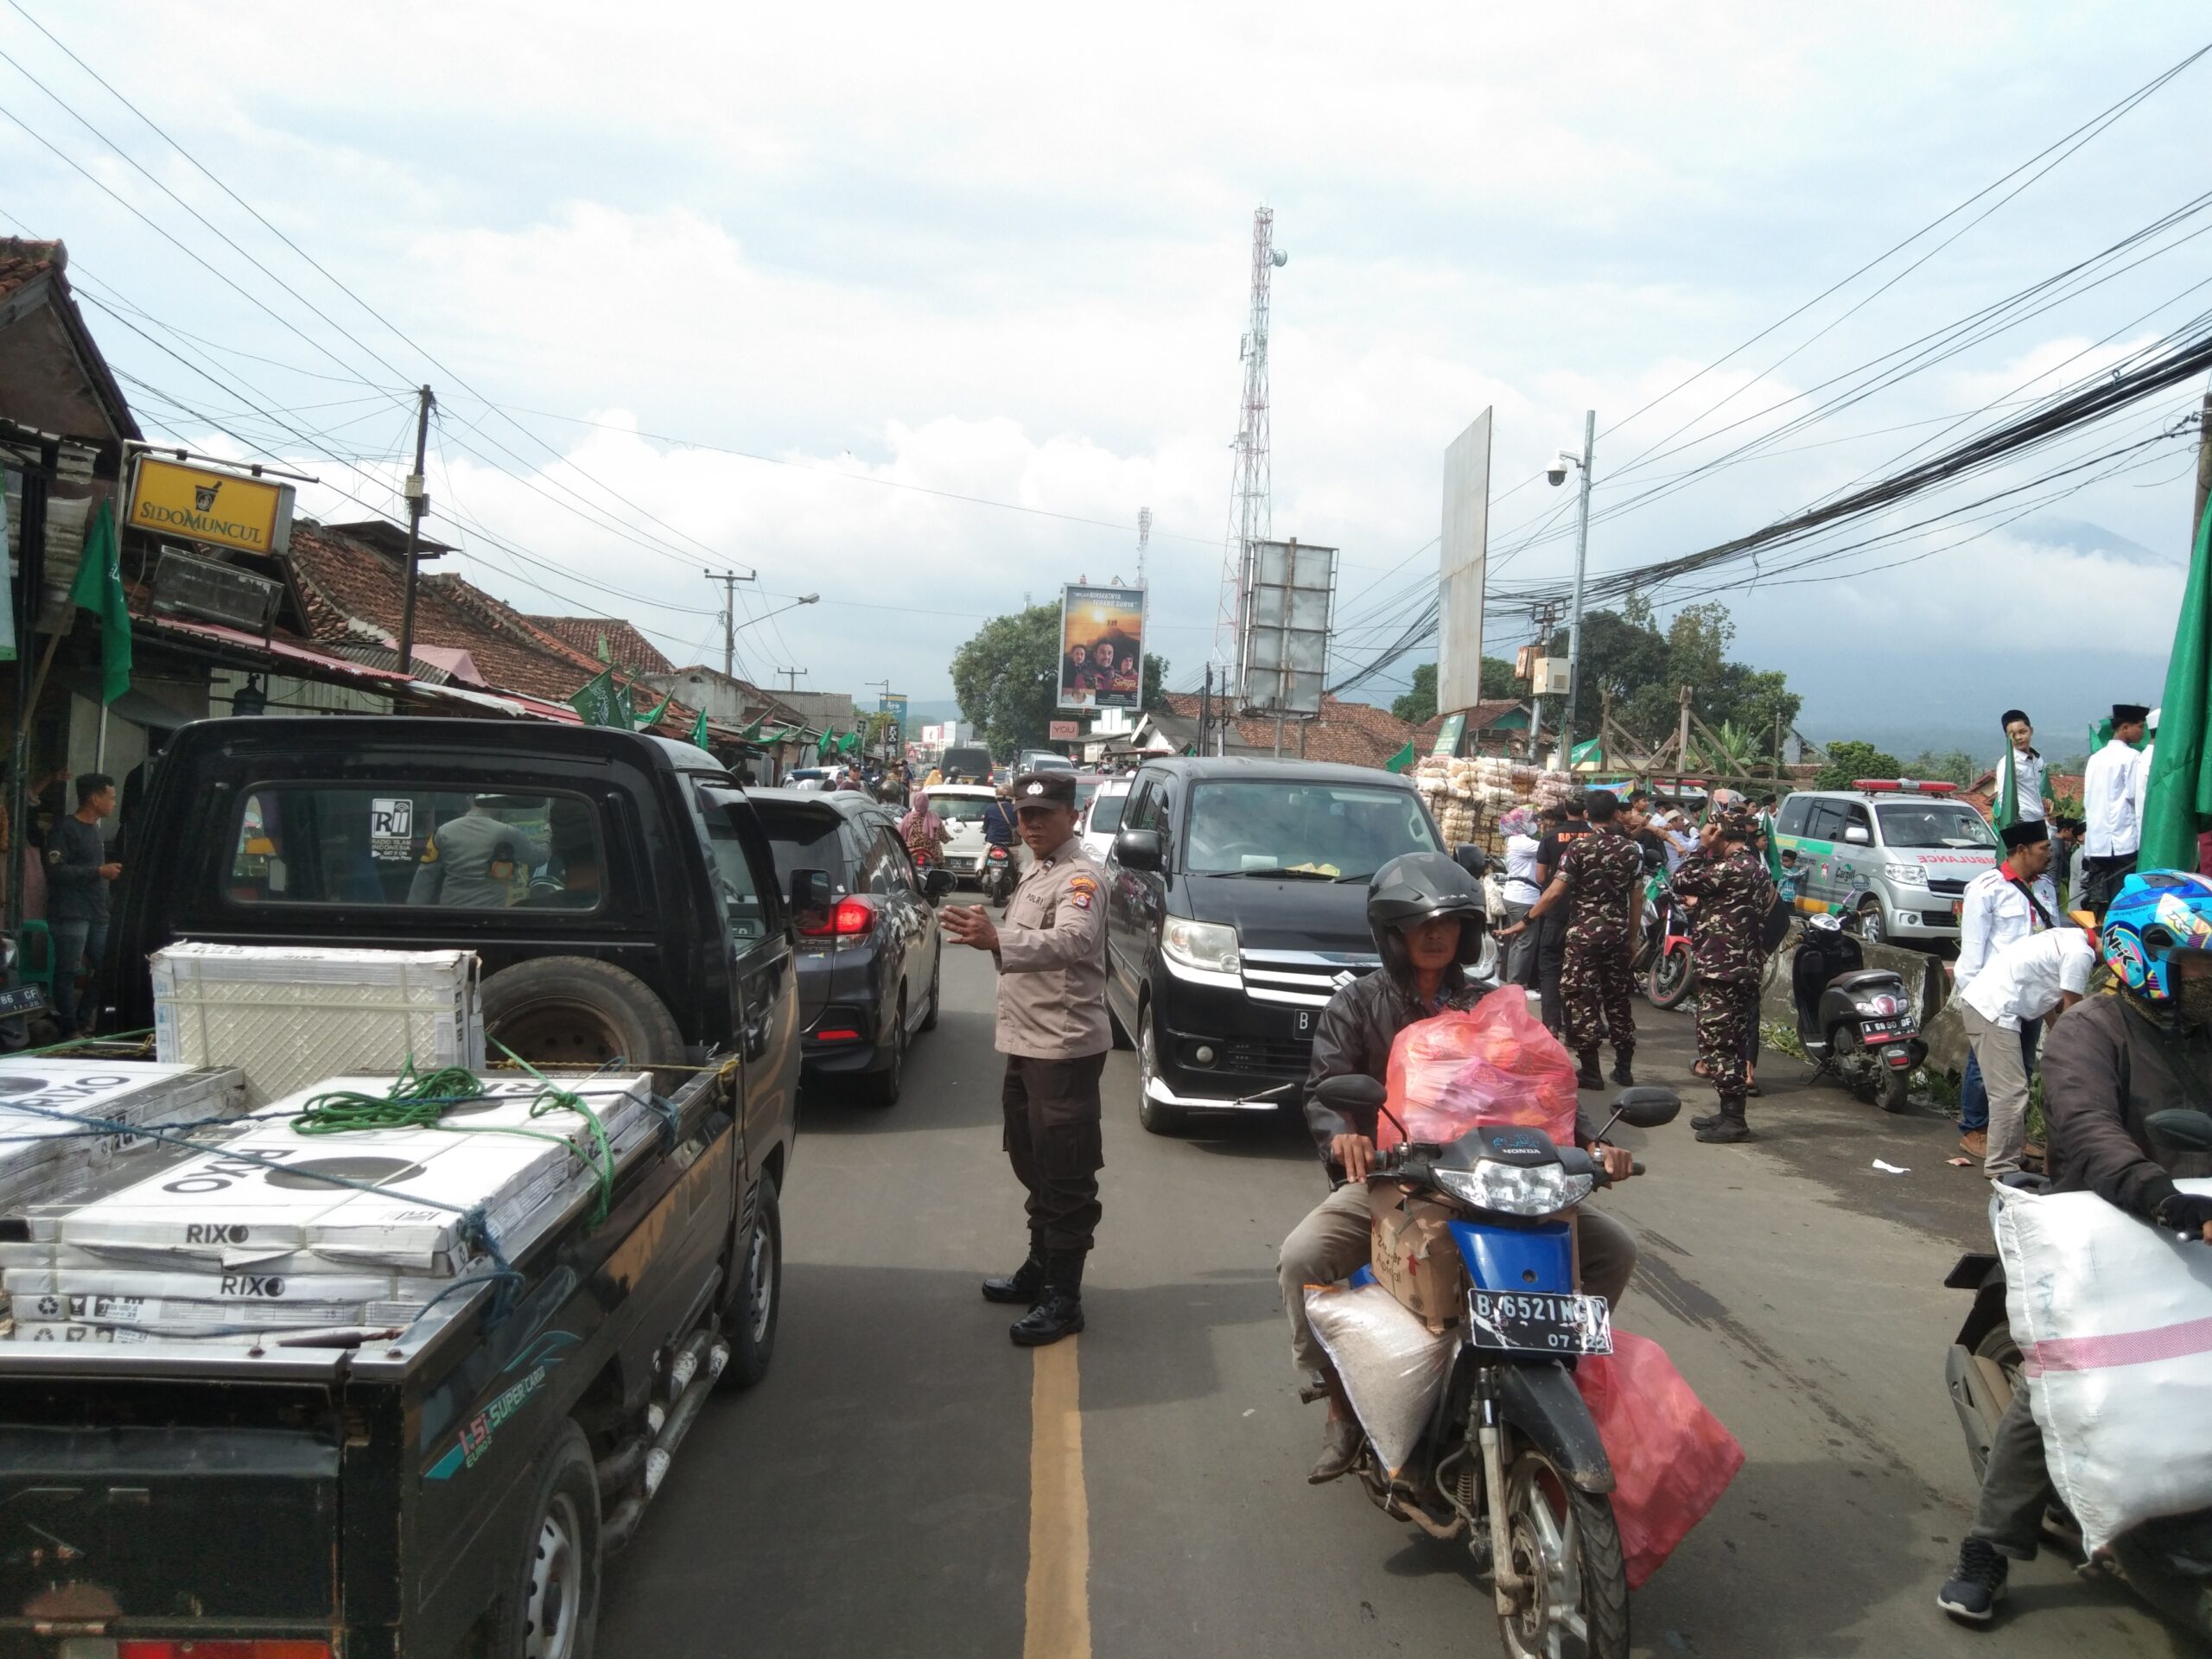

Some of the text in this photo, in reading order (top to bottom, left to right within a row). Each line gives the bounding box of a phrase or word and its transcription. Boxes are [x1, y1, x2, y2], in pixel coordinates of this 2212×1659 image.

[1026, 893, 1044, 906] POLRI
[2105, 925, 2137, 968] NHK
[1300, 1012, 1308, 1030] B
[1477, 1294, 1491, 1317] B
[1503, 1296, 1556, 1321] 6521
[489, 1382, 525, 1427] SUPER
[466, 1441, 487, 1468] EURO
